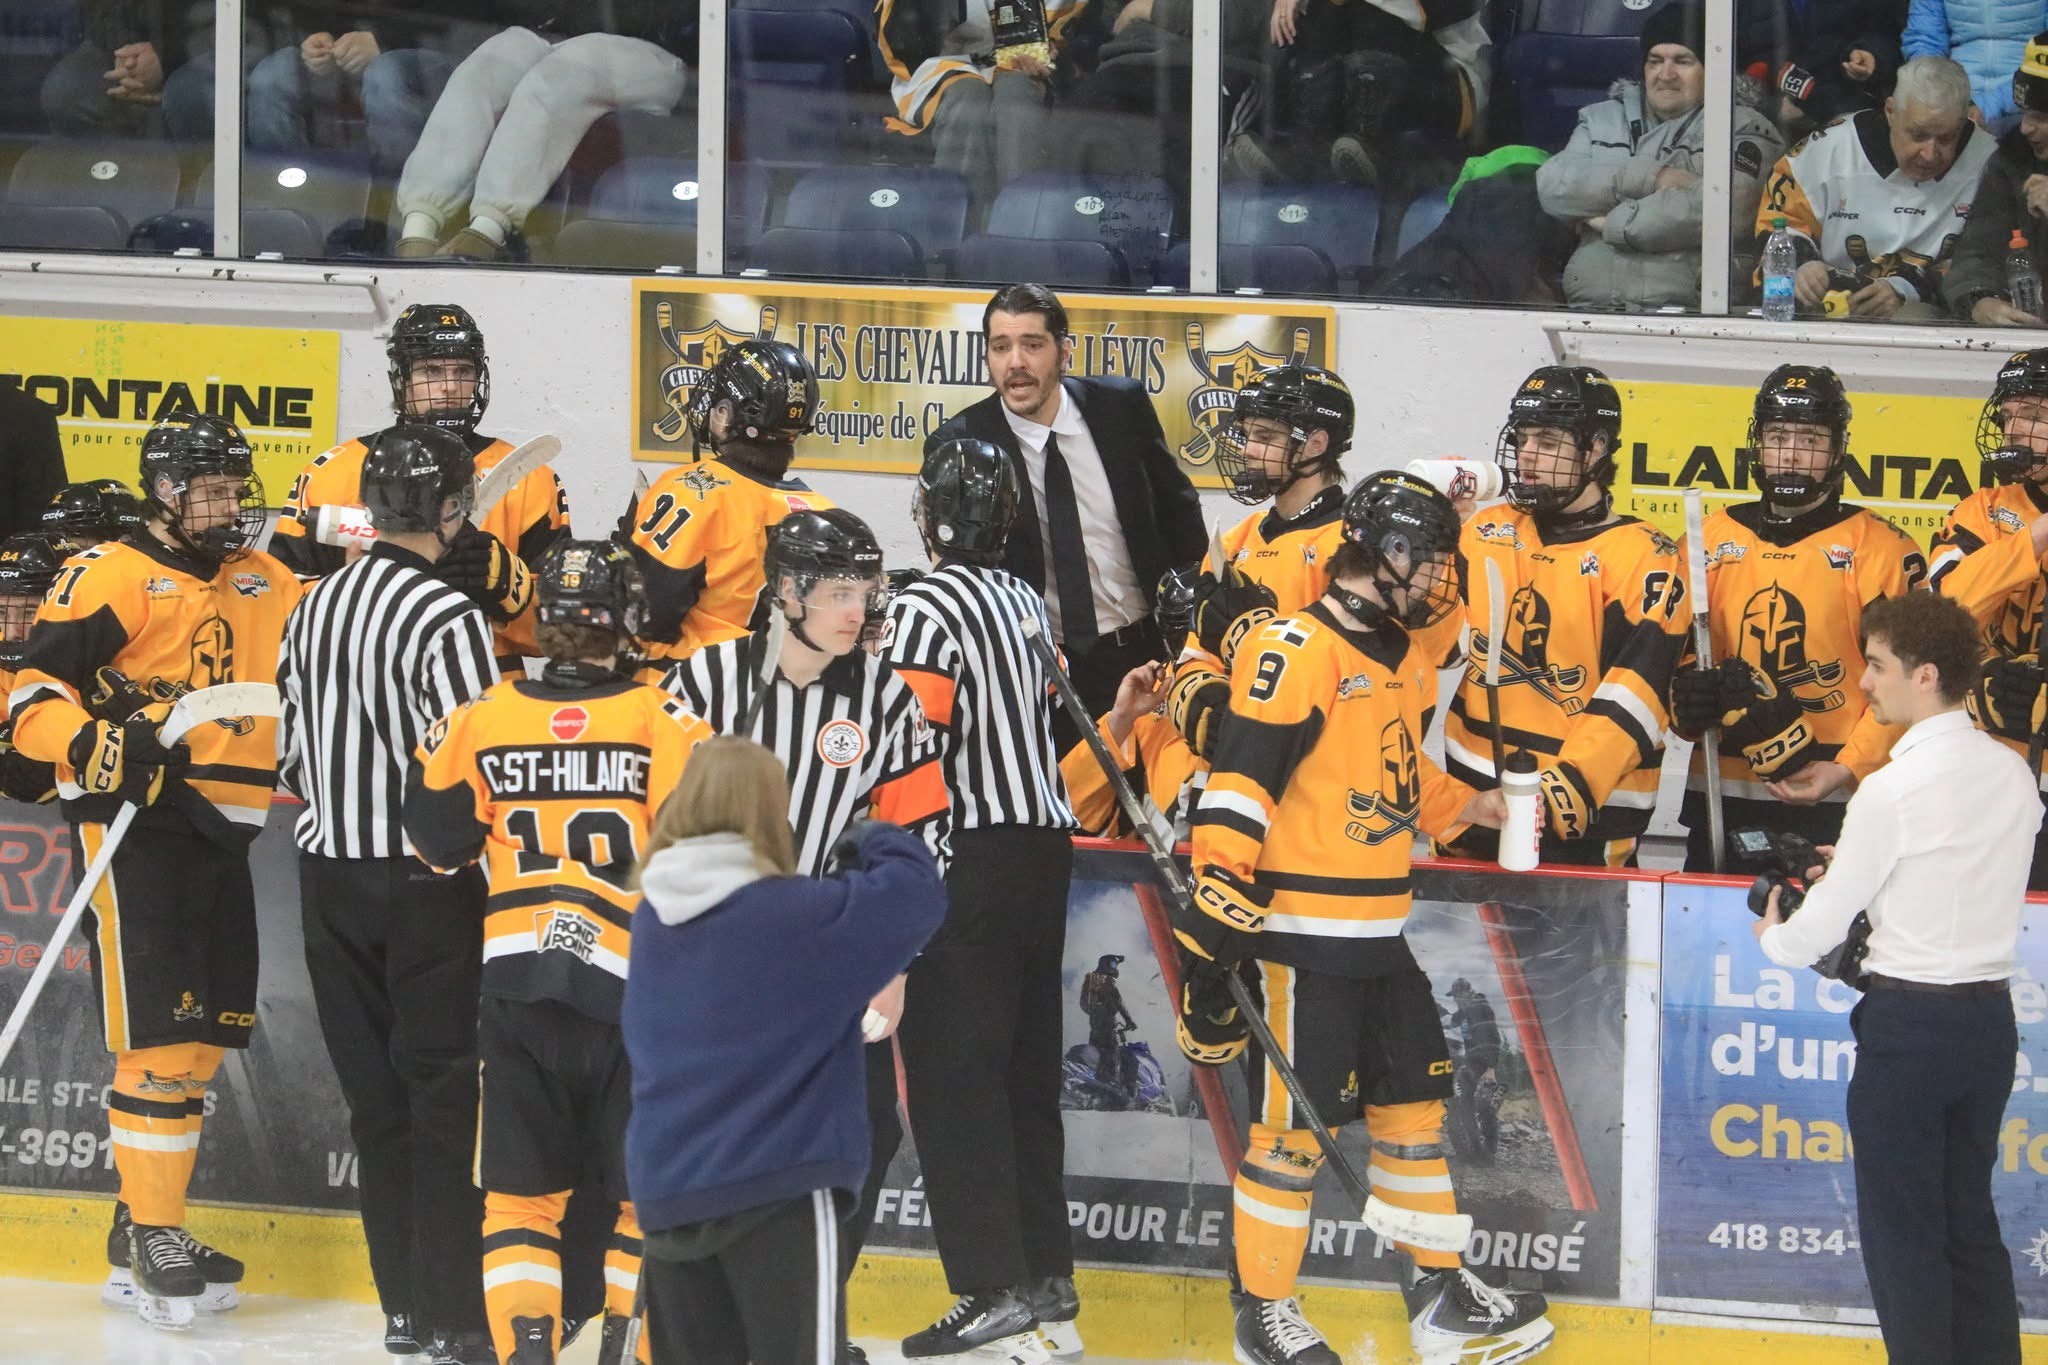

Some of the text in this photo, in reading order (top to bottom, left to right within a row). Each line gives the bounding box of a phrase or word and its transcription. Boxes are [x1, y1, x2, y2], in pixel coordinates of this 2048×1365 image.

[1083, 200, 1097, 211] 10
[1894, 206, 1927, 216] CCM
[440, 315, 458, 325] 21
[435, 332, 467, 341] CCM
[854, 324, 993, 388] CHEVALIE
[1085, 323, 1167, 395] LÉVIS
[2000, 367, 2025, 378] CCM
[1786, 378, 1808, 388] 22
[726, 380, 744, 400] CCM
[1514, 398, 1541, 408] CCM
[788, 406, 805, 419] 91
[1316, 406, 1343, 419] CCM
[1597, 408, 1619, 417] CCM
[891, 399, 917, 440] de
[72, 432, 114, 447] pour
[147, 451, 170, 460] CCM
[410, 464, 440, 477] CCM
[119, 514, 141, 523] CCM
[1391, 511, 1422, 526] CCM
[337, 523, 379, 539] CM
[0, 551, 19, 563] 84
[854, 552, 880, 561] CCM
[1255, 550, 1280, 558] CCM
[1761, 552, 1797, 561] CCM
[1248, 651, 1288, 702] 9
[1747, 724, 1807, 770] CCM
[94, 721, 124, 791] CCM
[1540, 769, 1581, 839] CCM
[1713, 954, 1796, 1011] La
[1067, 1200, 1166, 1244] POUR
[1174, 1206, 1225, 1247] LE
[1707, 1222, 1861, 1257] 418 834-
[956, 1311, 988, 1338] BAUER
[1466, 1314, 1505, 1324] BAUER
